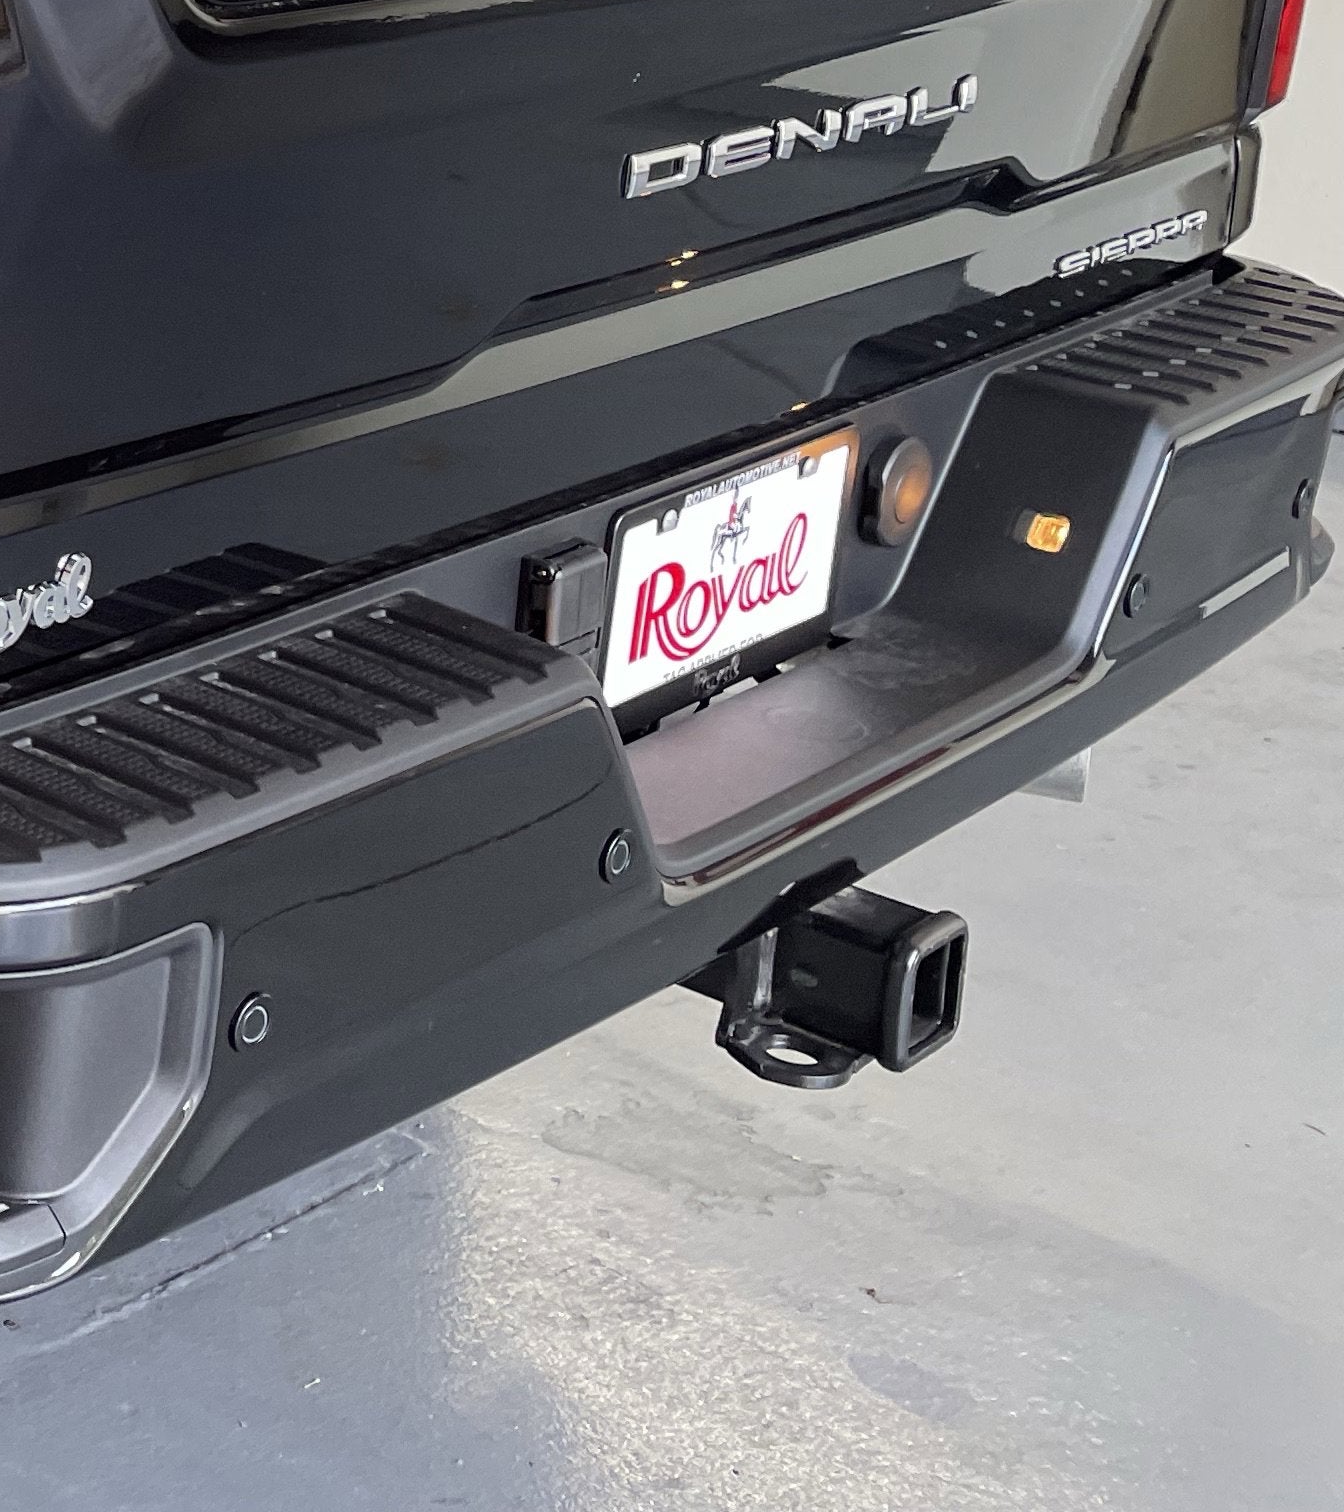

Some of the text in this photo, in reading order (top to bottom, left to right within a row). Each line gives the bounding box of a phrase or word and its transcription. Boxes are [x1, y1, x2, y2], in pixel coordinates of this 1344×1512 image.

[620, 73, 979, 199] DENALI
[1053, 209, 1208, 279] SIERRA
[628, 512, 809, 663] Royal
